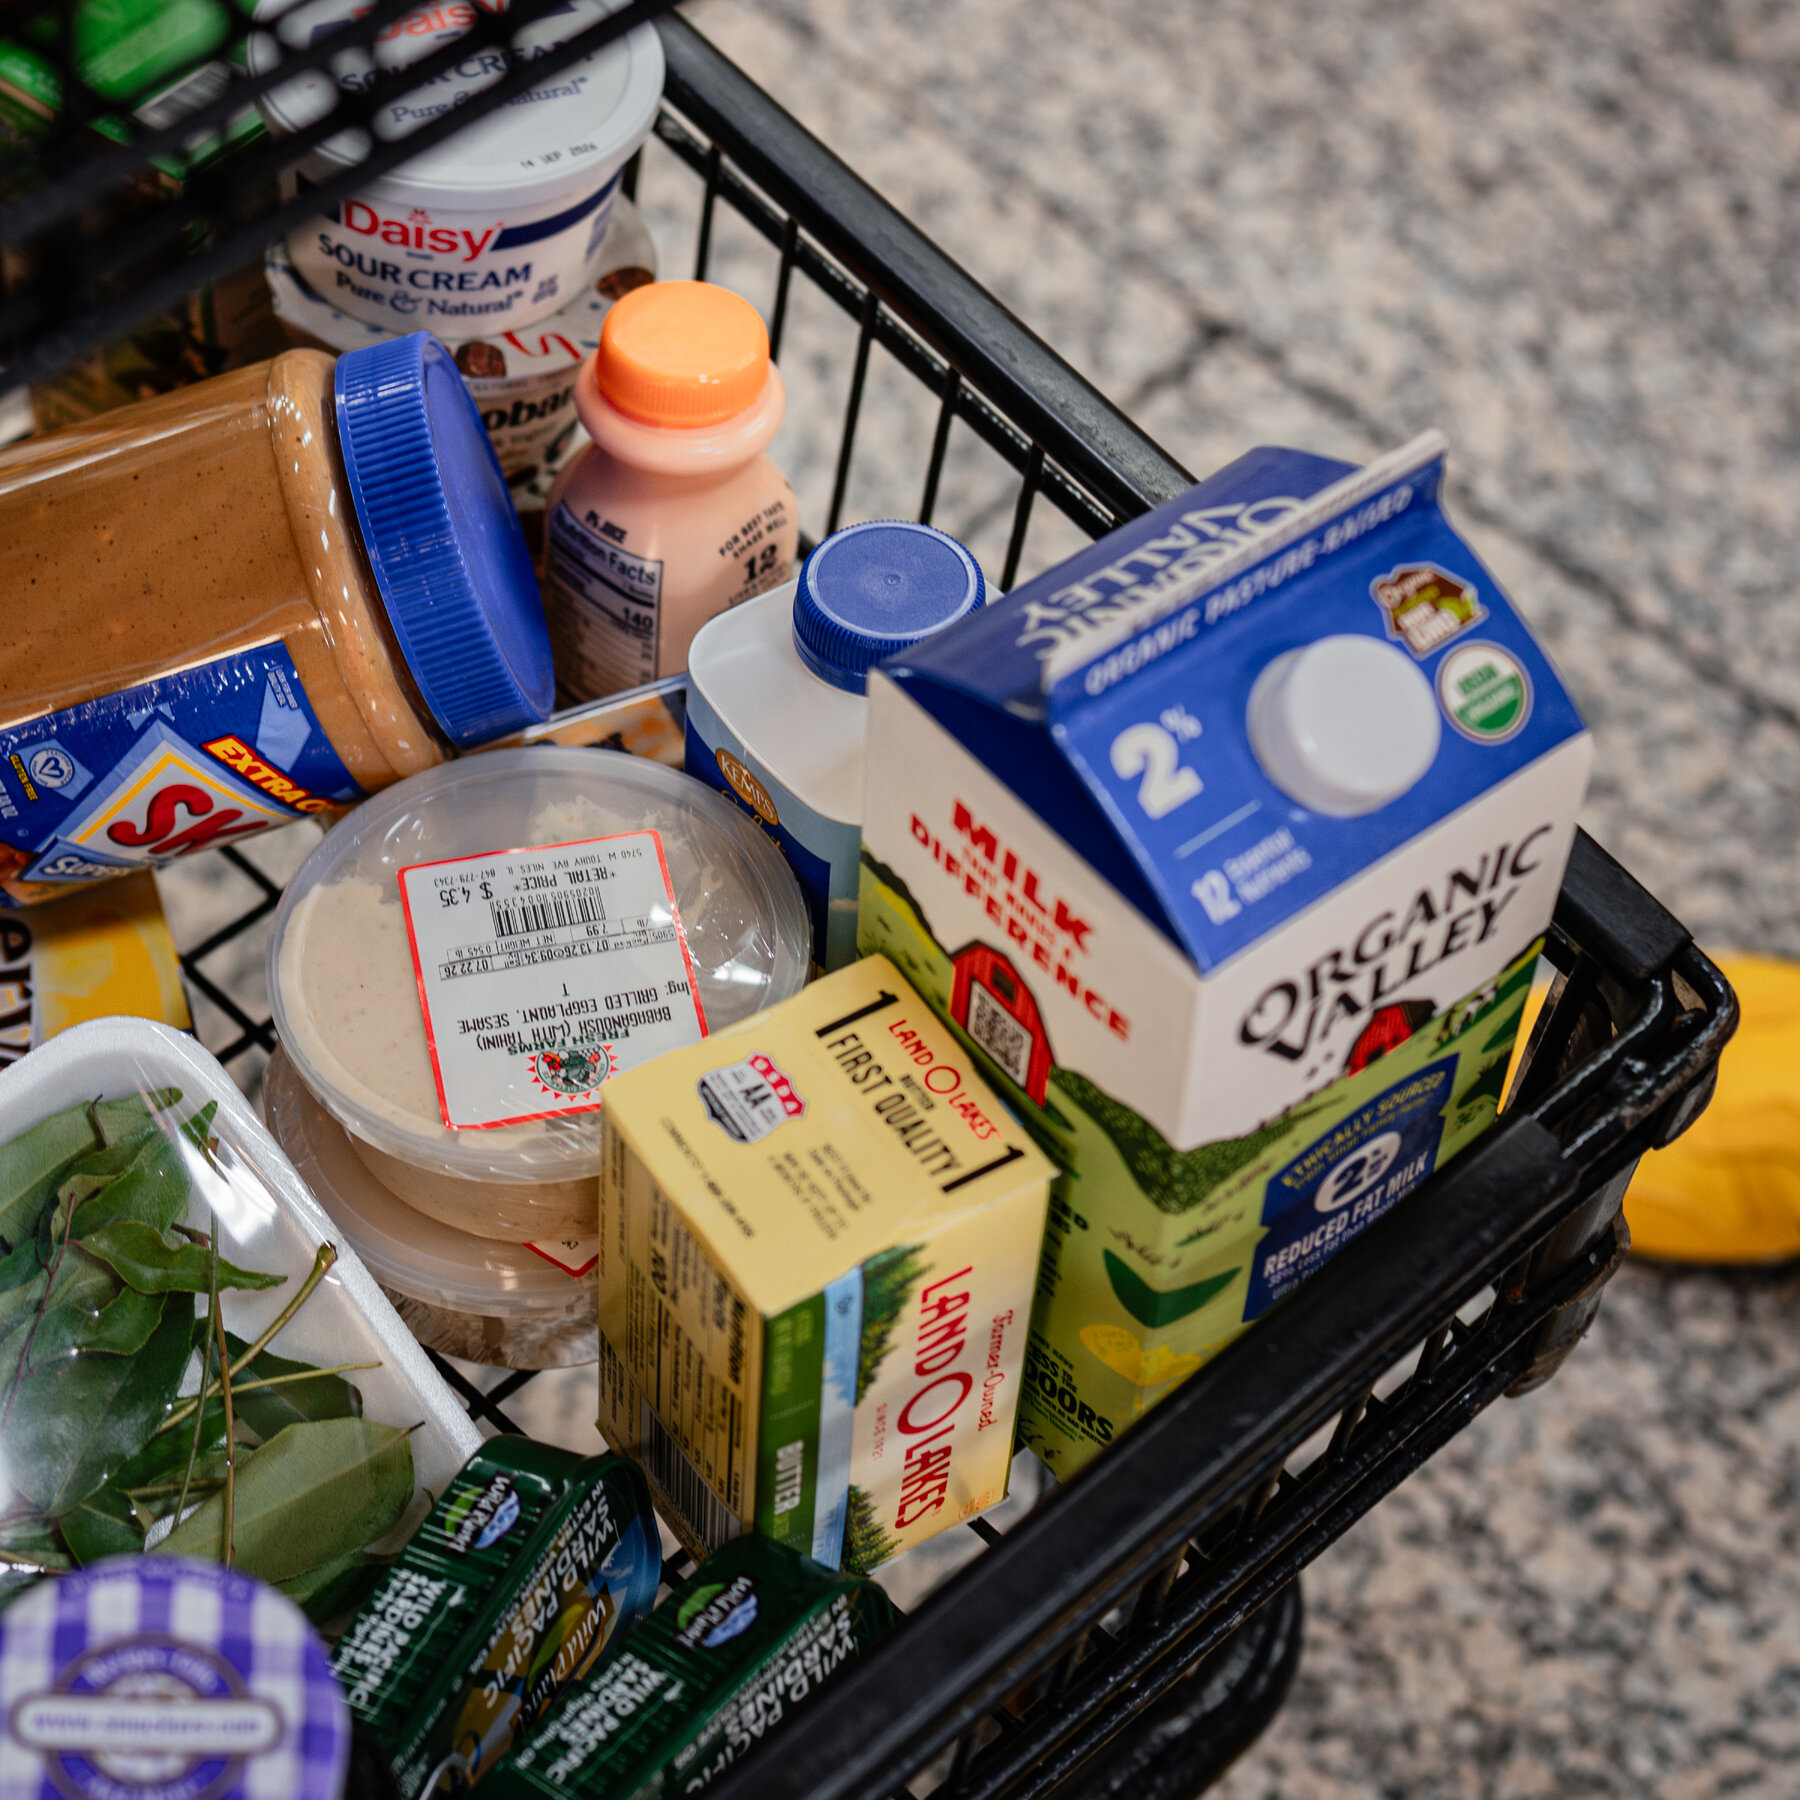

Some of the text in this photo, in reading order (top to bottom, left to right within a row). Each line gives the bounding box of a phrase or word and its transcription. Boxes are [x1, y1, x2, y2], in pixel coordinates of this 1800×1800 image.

[344, 199, 497, 263] Daisy
[318, 233, 403, 286] SOUR
[407, 262, 533, 291] CREAM
[337, 270, 386, 302] Pure
[389, 289, 423, 314] &
[609, 552, 656, 585] Facts
[719, 534, 740, 558] FOR
[1020, 502, 1247, 631] VALLEY
[1083, 485, 1413, 696] ORGANIC PASTURE-RAISED
[208, 738, 307, 804] EXTRA
[721, 754, 775, 818] KEMPS
[434, 868, 496, 888] 847-779-7343
[440, 882, 493, 908] $ 4.35
[952, 797, 1095, 957] MILK
[1190, 868, 1243, 926] 12
[536, 935, 553, 946] NET
[586, 923, 607, 937] 7.99
[652, 929, 674, 941] 5905
[909, 812, 1131, 1043] DIFFERENCE
[1238, 822, 1553, 1046] ORGANIC
[444, 959, 490, 978] 07.22.26
[562, 982, 570, 997] T
[665, 980, 690, 996] Ing:
[1263, 883, 1521, 1063] VALLEY
[457, 1013, 510, 1034] SESAME
[604, 987, 658, 1010] GRILLED
[815, 990, 899, 1038] 1
[476, 1006, 672, 1051] BABAGANOUSH (WITH TAHINI)
[753, 1058, 799, 1113] USDA
[827, 1033, 893, 1095] FIRST
[888, 1019, 998, 1141] LAND O LAKES
[739, 1083, 772, 1110] AA
[874, 1092, 963, 1176] QUALITY
[1281, 1070, 1446, 1187] ETHICALLY SOURCED
[941, 1144, 1025, 1193] 1
[1263, 1151, 1430, 1278] REDUCED FAT MILK
[894, 1264, 974, 1530] LAND O LAKES
[1061, 1369, 1073, 1383] TO
[1062, 1378, 1078, 1394] THE
[591, 1479, 604, 1501] IN
[773, 1438, 804, 1517] BUTTER
[557, 1498, 592, 1549] EXTRA
[511, 1495, 609, 1637] SARDINES
[482, 1516, 614, 1711] WILD PACIFIC
[566, 1597, 608, 1654] Wild
[832, 1593, 848, 1616] IN
[350, 1578, 448, 1707] WILD PACIFIC
[789, 1635, 855, 1703] WILD
[559, 1658, 651, 1743] SARDINES
[724, 1610, 852, 1748] SARDINES
[545, 1669, 668, 1785] WILD PACIFIC
